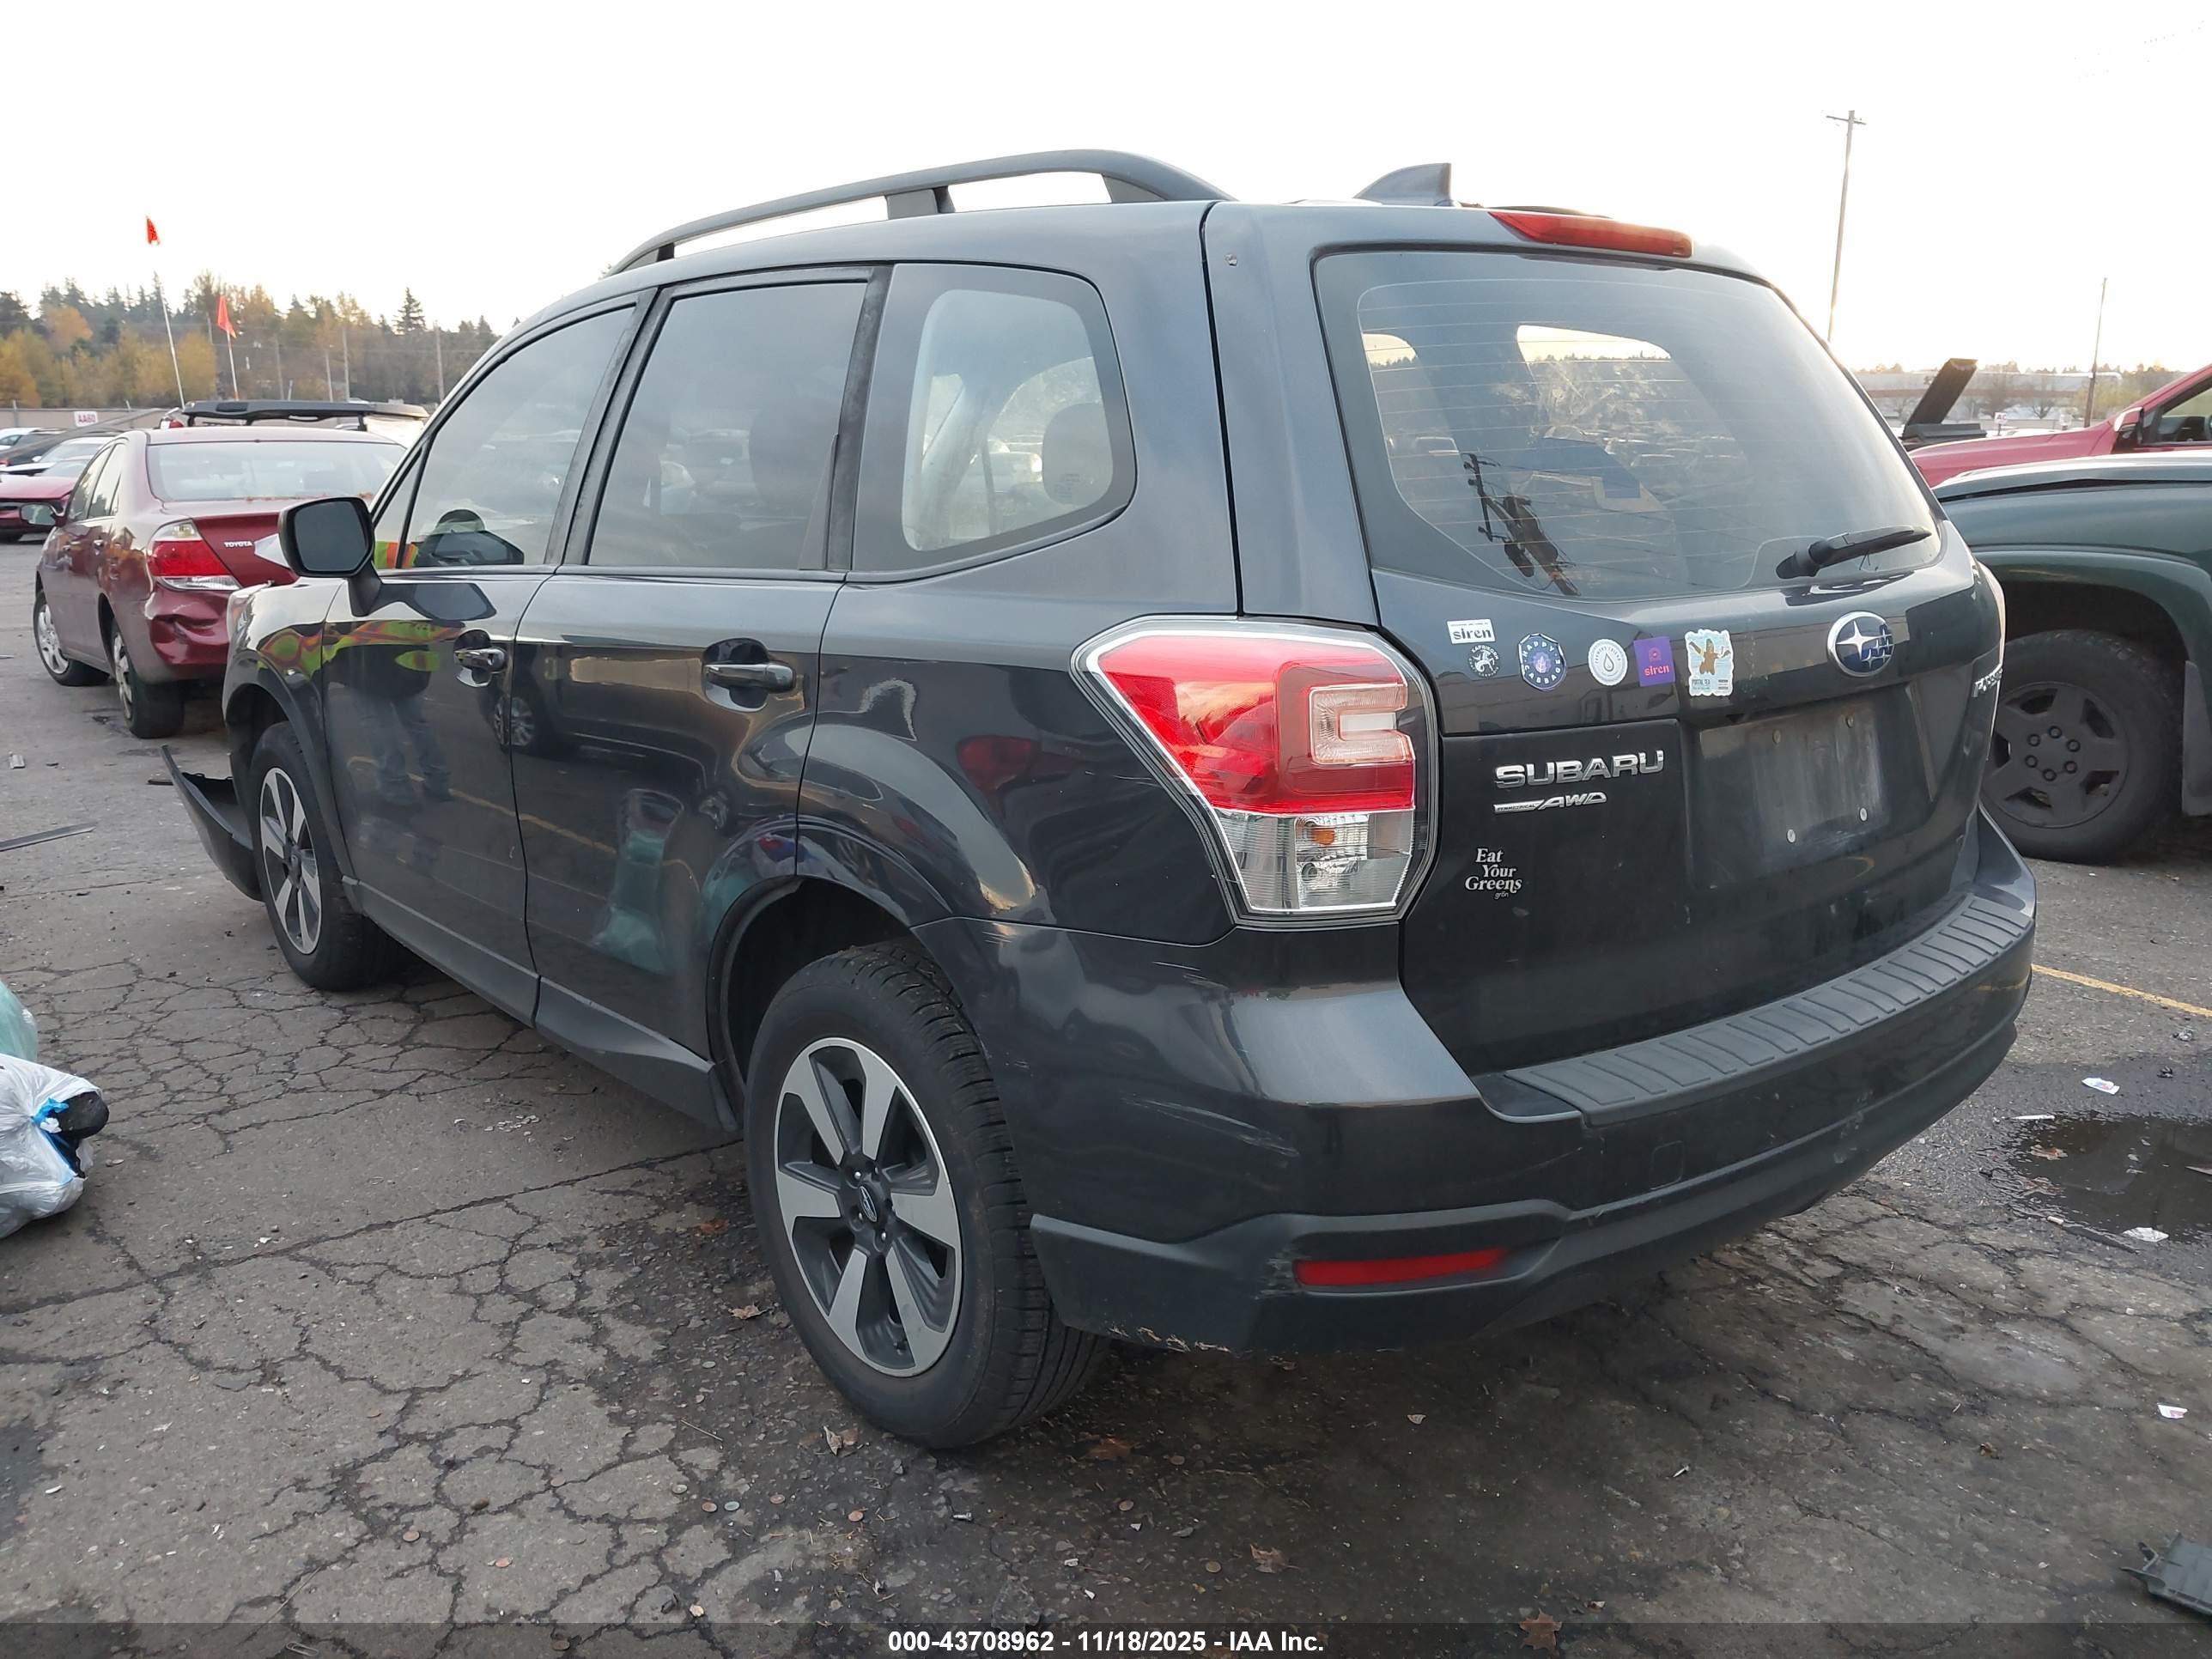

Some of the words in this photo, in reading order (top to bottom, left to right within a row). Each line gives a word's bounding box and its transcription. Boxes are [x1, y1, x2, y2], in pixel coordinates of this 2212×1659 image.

[1453, 628, 1492, 640] siren
[1644, 665, 1670, 677] siren
[1494, 750, 1665, 789] SUBARU
[1537, 792, 1607, 810] AWD
[1475, 848, 1504, 863] Eat
[1482, 864, 1516, 878] Your
[1465, 876, 1522, 894] Greens
